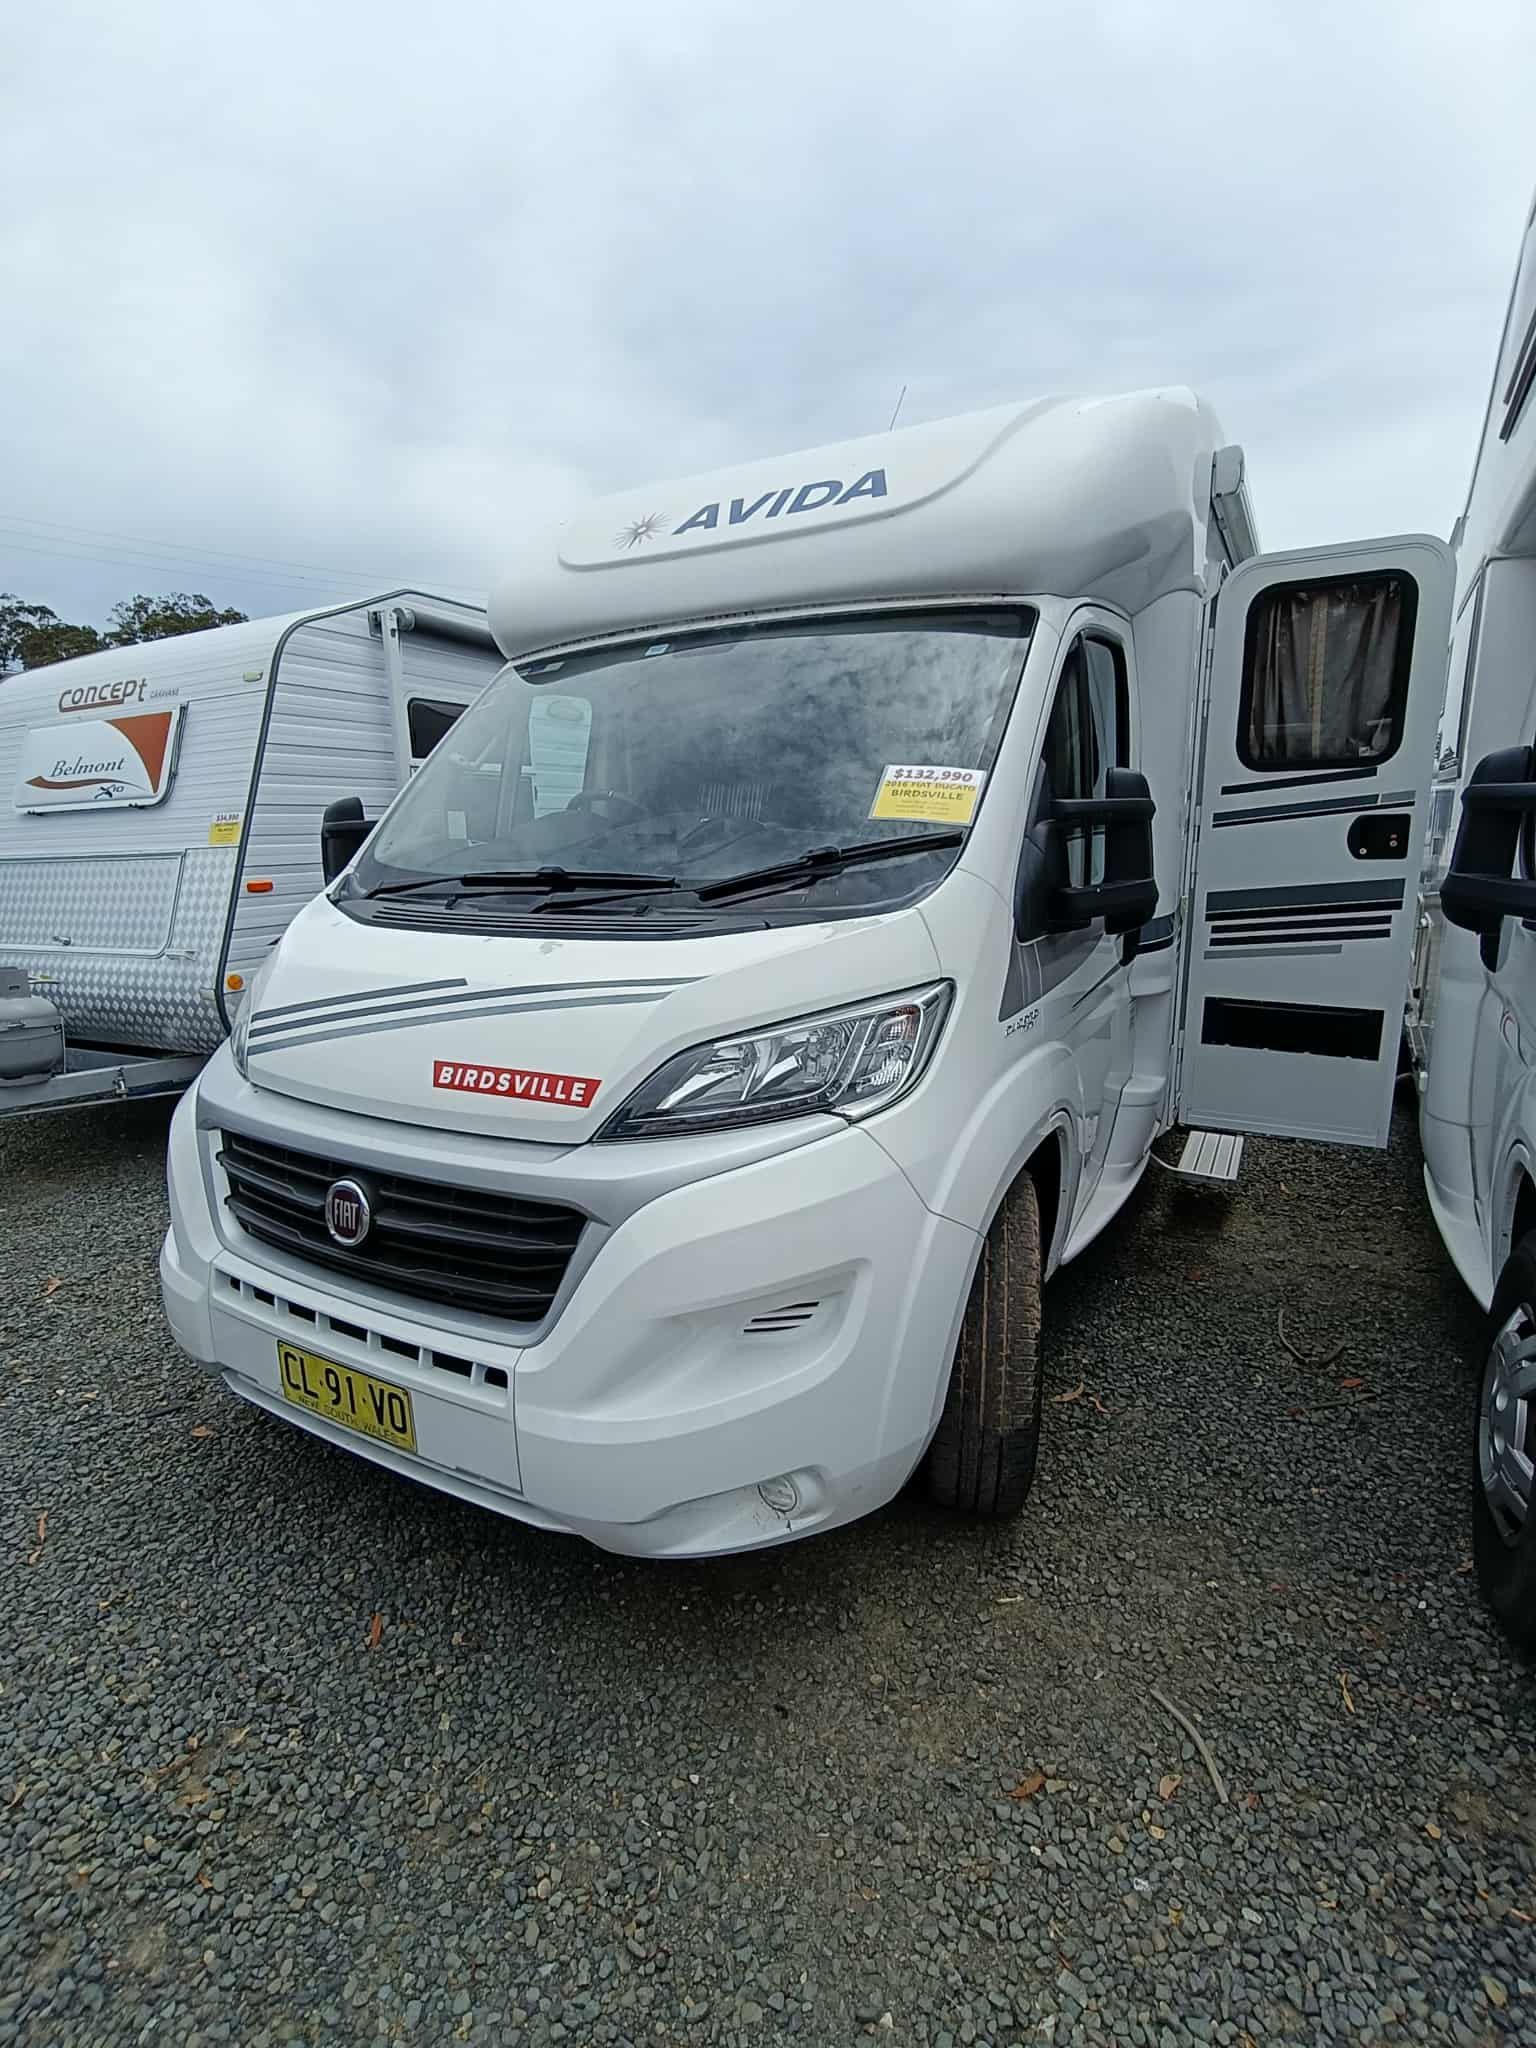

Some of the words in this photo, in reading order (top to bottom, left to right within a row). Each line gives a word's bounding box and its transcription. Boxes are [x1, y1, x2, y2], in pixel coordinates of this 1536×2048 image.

[671, 468, 888, 536] AVIDA
[49, 756, 125, 777] Belmont
[893, 768, 973, 783] $132,990
[891, 789, 965, 801] BIRDSVILLE
[935, 783, 976, 792] DUCATO
[438, 1066, 587, 1102] BIRDSVILLE
[334, 1198, 360, 1231] FIAT
